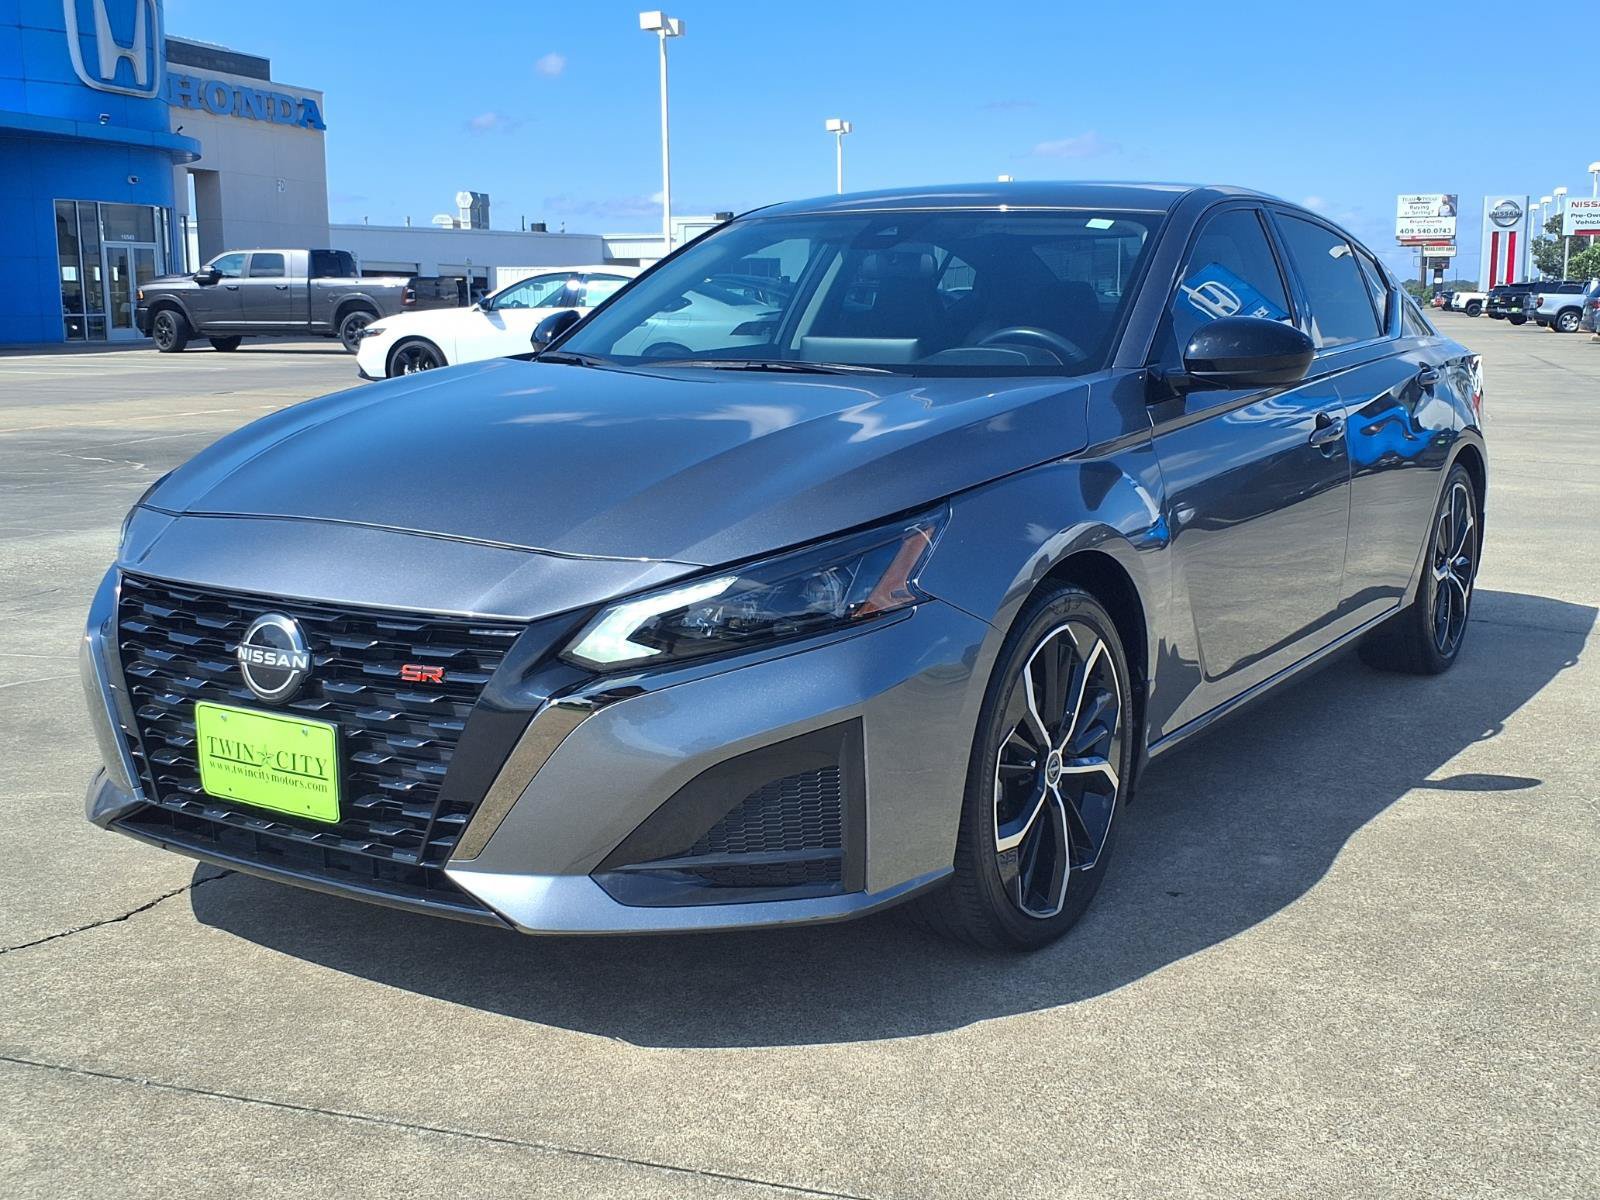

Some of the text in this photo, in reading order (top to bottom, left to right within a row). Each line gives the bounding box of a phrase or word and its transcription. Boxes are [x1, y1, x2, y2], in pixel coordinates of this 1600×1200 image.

[167, 72, 327, 131] HONDA
[237, 645, 308, 671] NISSAN
[400, 662, 445, 684] SR
[206, 735, 327, 776] TWIN CITY
[209, 758, 328, 794] www.twincitymotors.com
